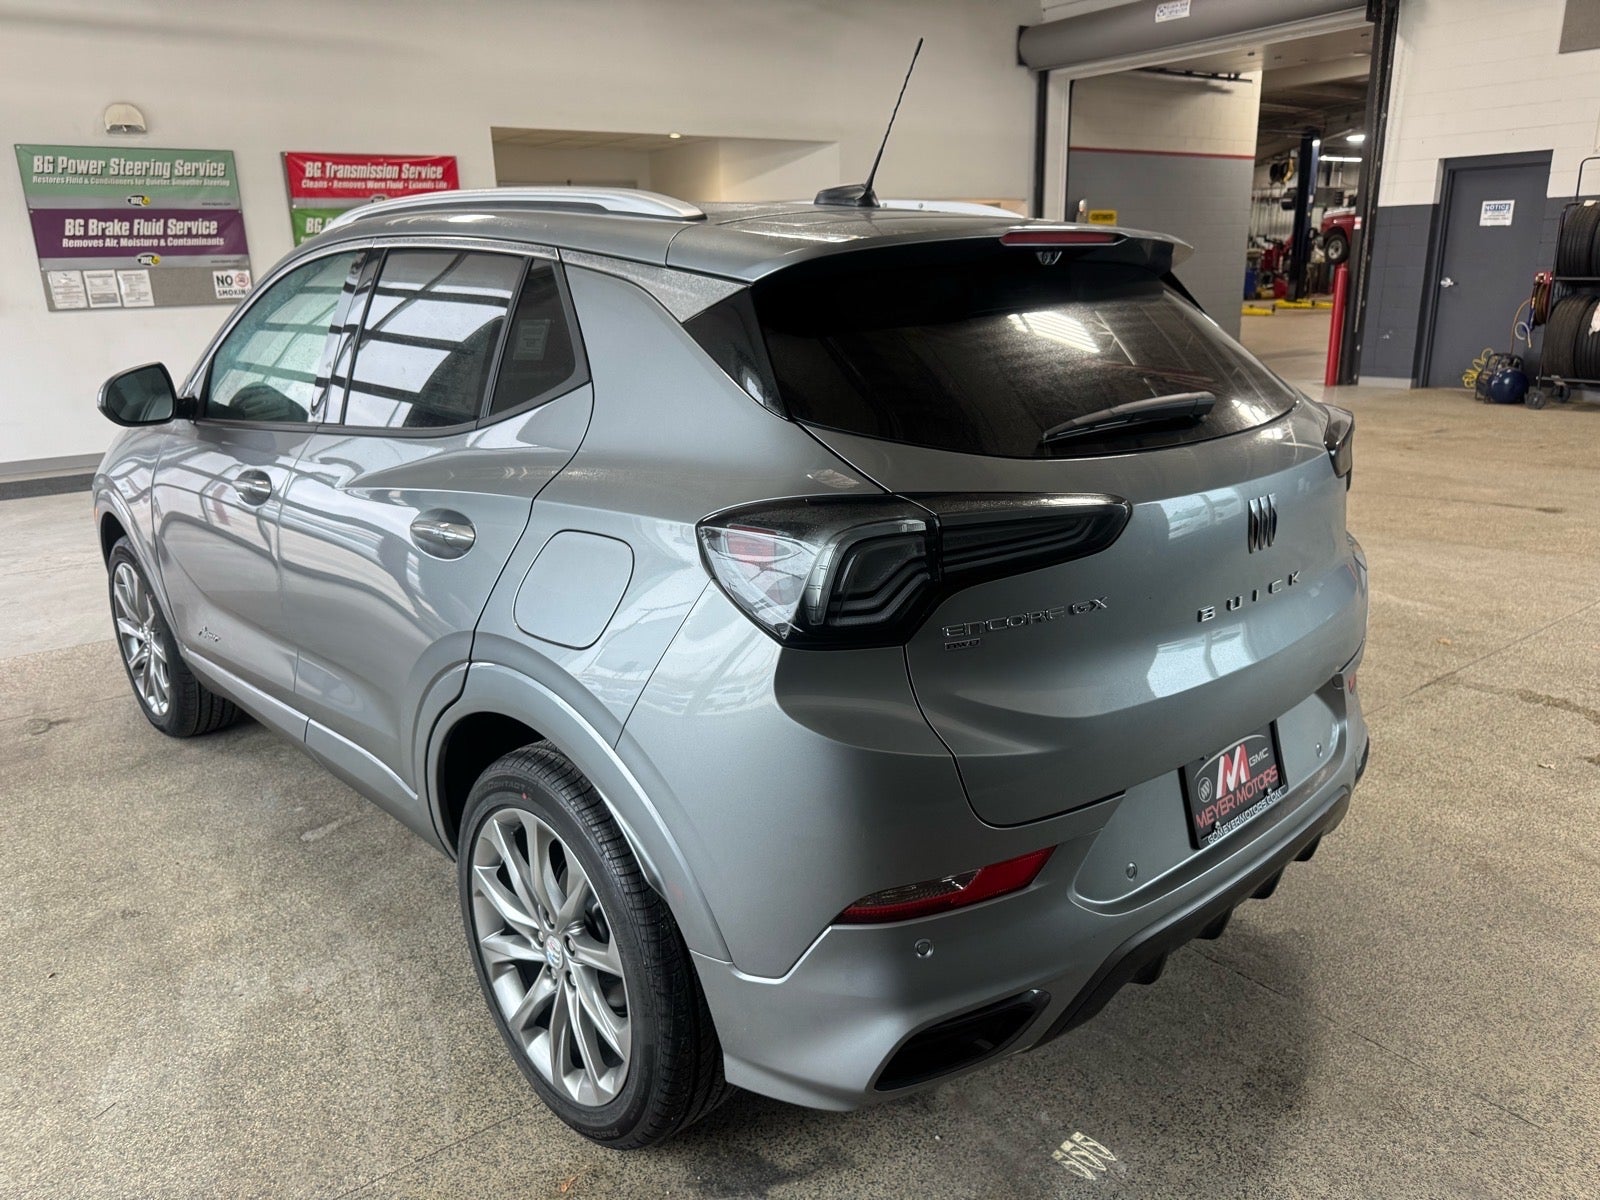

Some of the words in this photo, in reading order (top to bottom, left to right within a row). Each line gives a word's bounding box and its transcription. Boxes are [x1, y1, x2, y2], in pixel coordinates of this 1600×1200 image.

[33, 155, 55, 174] BG
[57, 156, 107, 176] Power
[109, 157, 172, 179] Steering
[174, 159, 226, 177] Service
[305, 161, 322, 178] BG
[325, 162, 400, 179] Transmission
[401, 163, 443, 179] Service
[32, 175, 65, 184] Restores
[65, 176, 83, 184] Fluid
[301, 179, 328, 189] Cleans
[333, 180, 366, 189] Removes
[386, 180, 404, 189] Fluid
[64, 218, 85, 236] BG
[88, 218, 130, 236] Brake
[132, 218, 164, 236] Fluid
[166, 218, 218, 236] Service
[305, 217, 323, 234] BG
[62, 238, 104, 248] Removes
[104, 237, 119, 248] Air,
[120, 237, 159, 247] Moisture
[159, 238, 166, 247] &
[167, 237, 225, 247] Contaminants
[215, 274, 233, 287] NO
[1197, 571, 1300, 623] BUICK
[941, 605, 1065, 637] ENCORE
[1068, 596, 1108, 615] GX
[1249, 747, 1269, 767] GMC
[1195, 794, 1236, 829] MEYER
[1236, 764, 1279, 806] MOTORS
